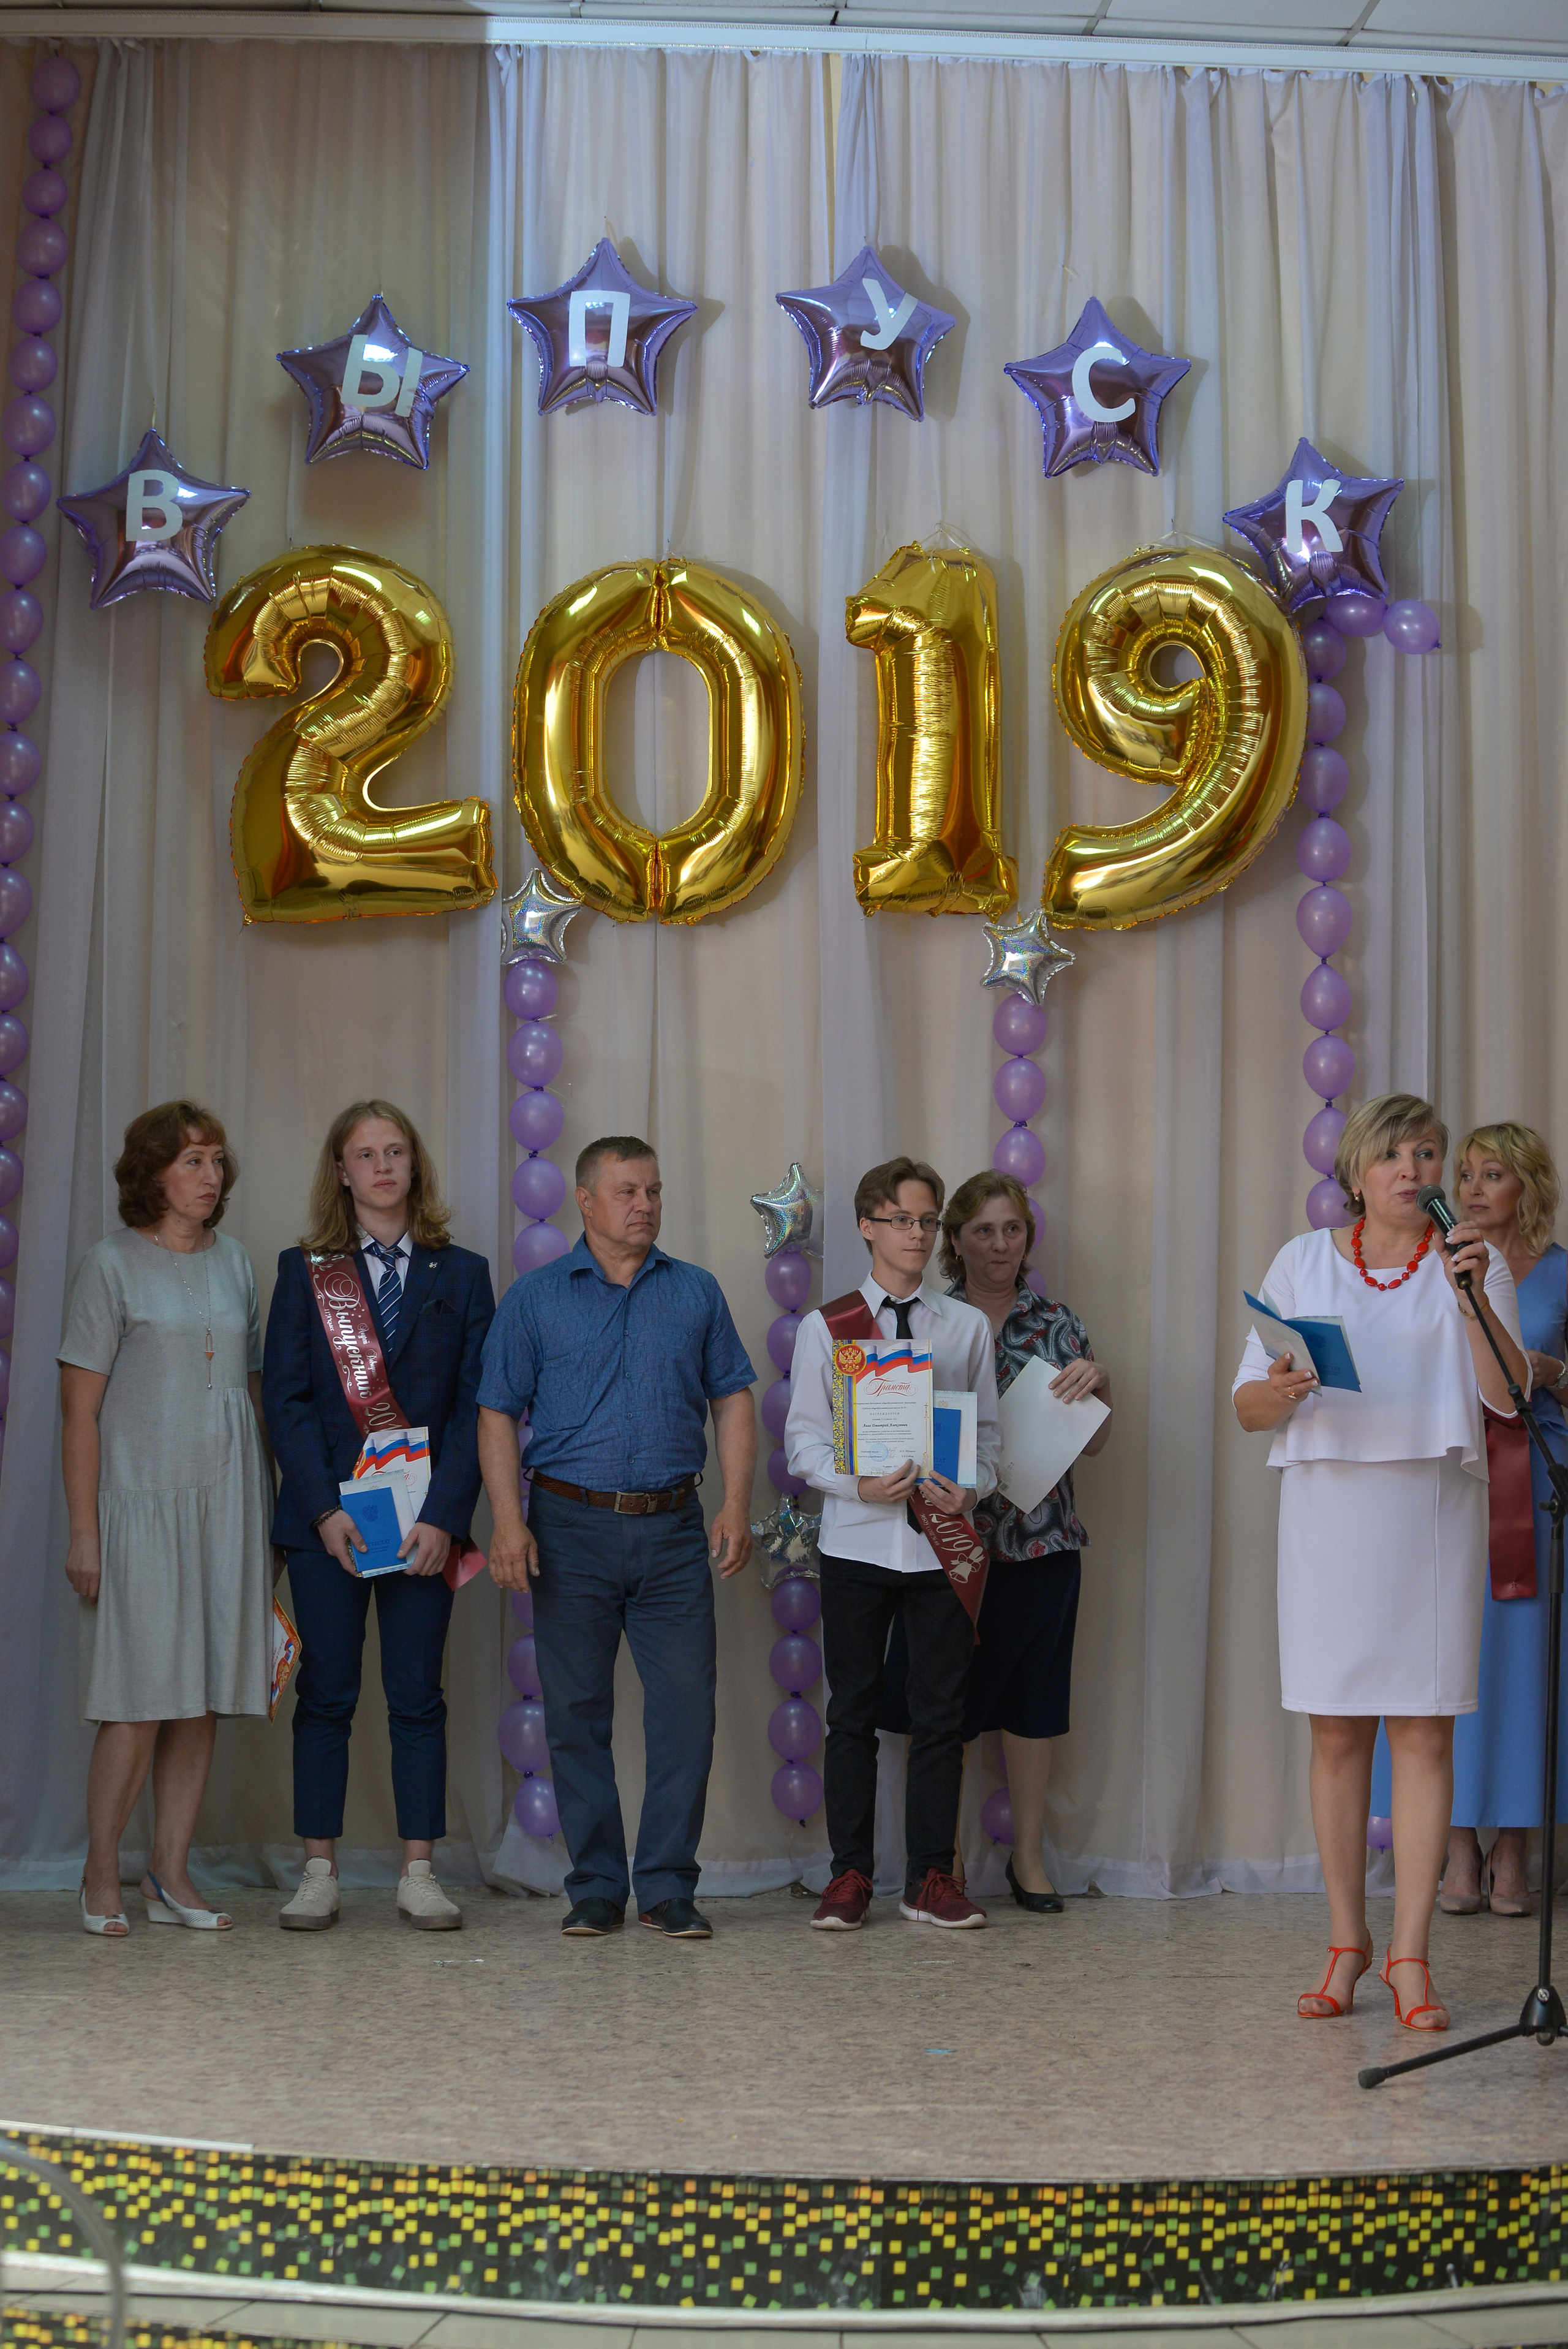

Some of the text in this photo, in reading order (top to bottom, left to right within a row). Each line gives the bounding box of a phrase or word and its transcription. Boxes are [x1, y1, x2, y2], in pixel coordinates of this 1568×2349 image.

[205, 542, 1311, 932] 2019
[323, 1271, 372, 1399] Выпускник
[864, 1377, 918, 1398] Грамота
[363, 1402, 402, 1432] 201
[368, 1538, 391, 1548] ТТЕСТАТ
[929, 1513, 974, 1552] 2019
